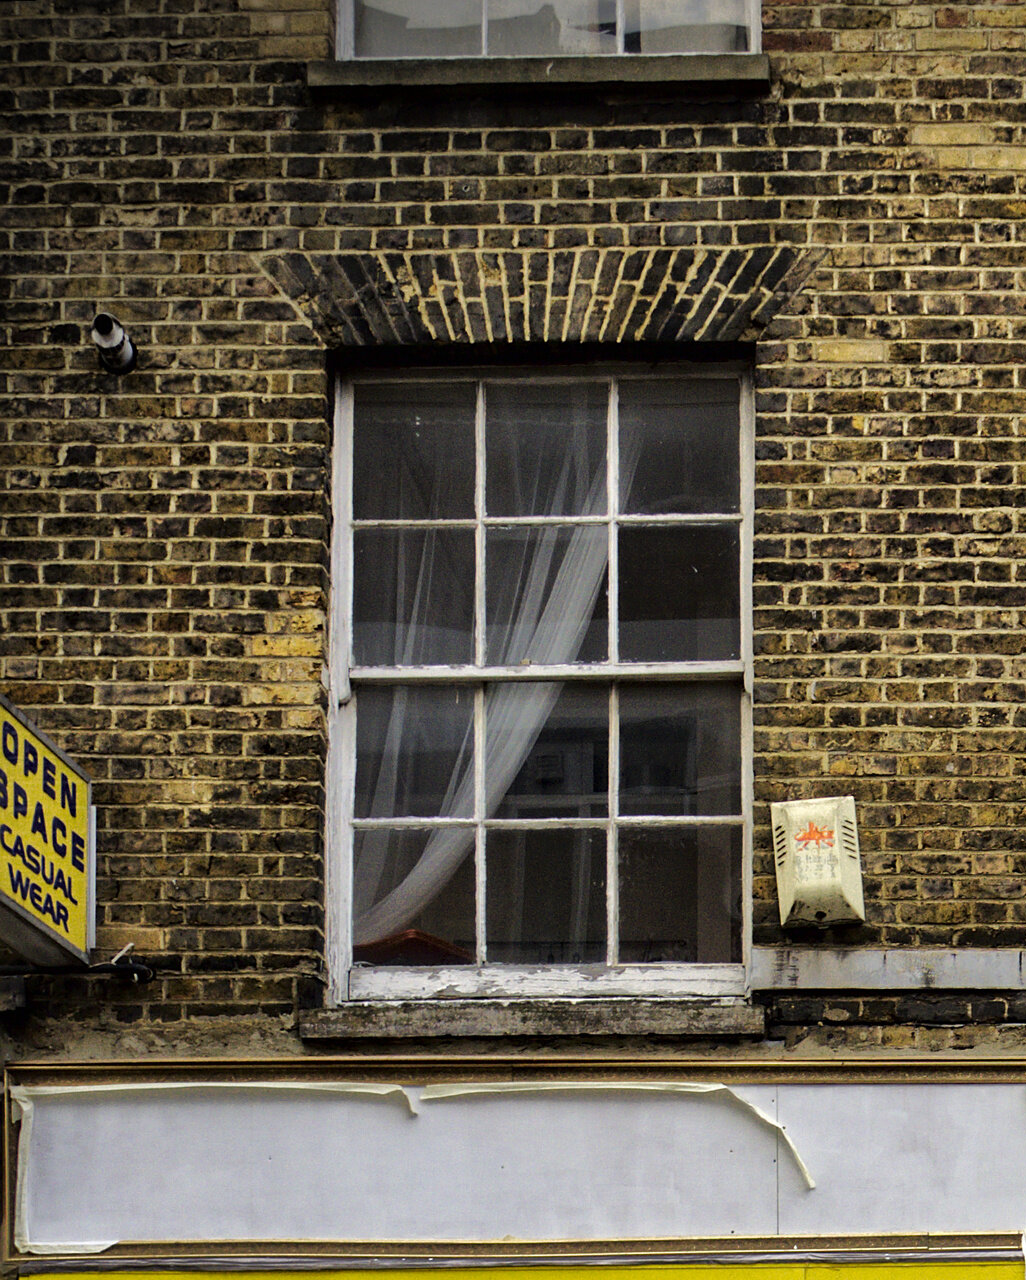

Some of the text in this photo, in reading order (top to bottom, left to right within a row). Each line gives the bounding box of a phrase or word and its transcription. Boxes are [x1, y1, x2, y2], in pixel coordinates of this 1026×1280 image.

[2, 720, 77, 818] OPEN
[0, 823, 78, 906] CASUAL
[8, 862, 70, 933] WEAR
